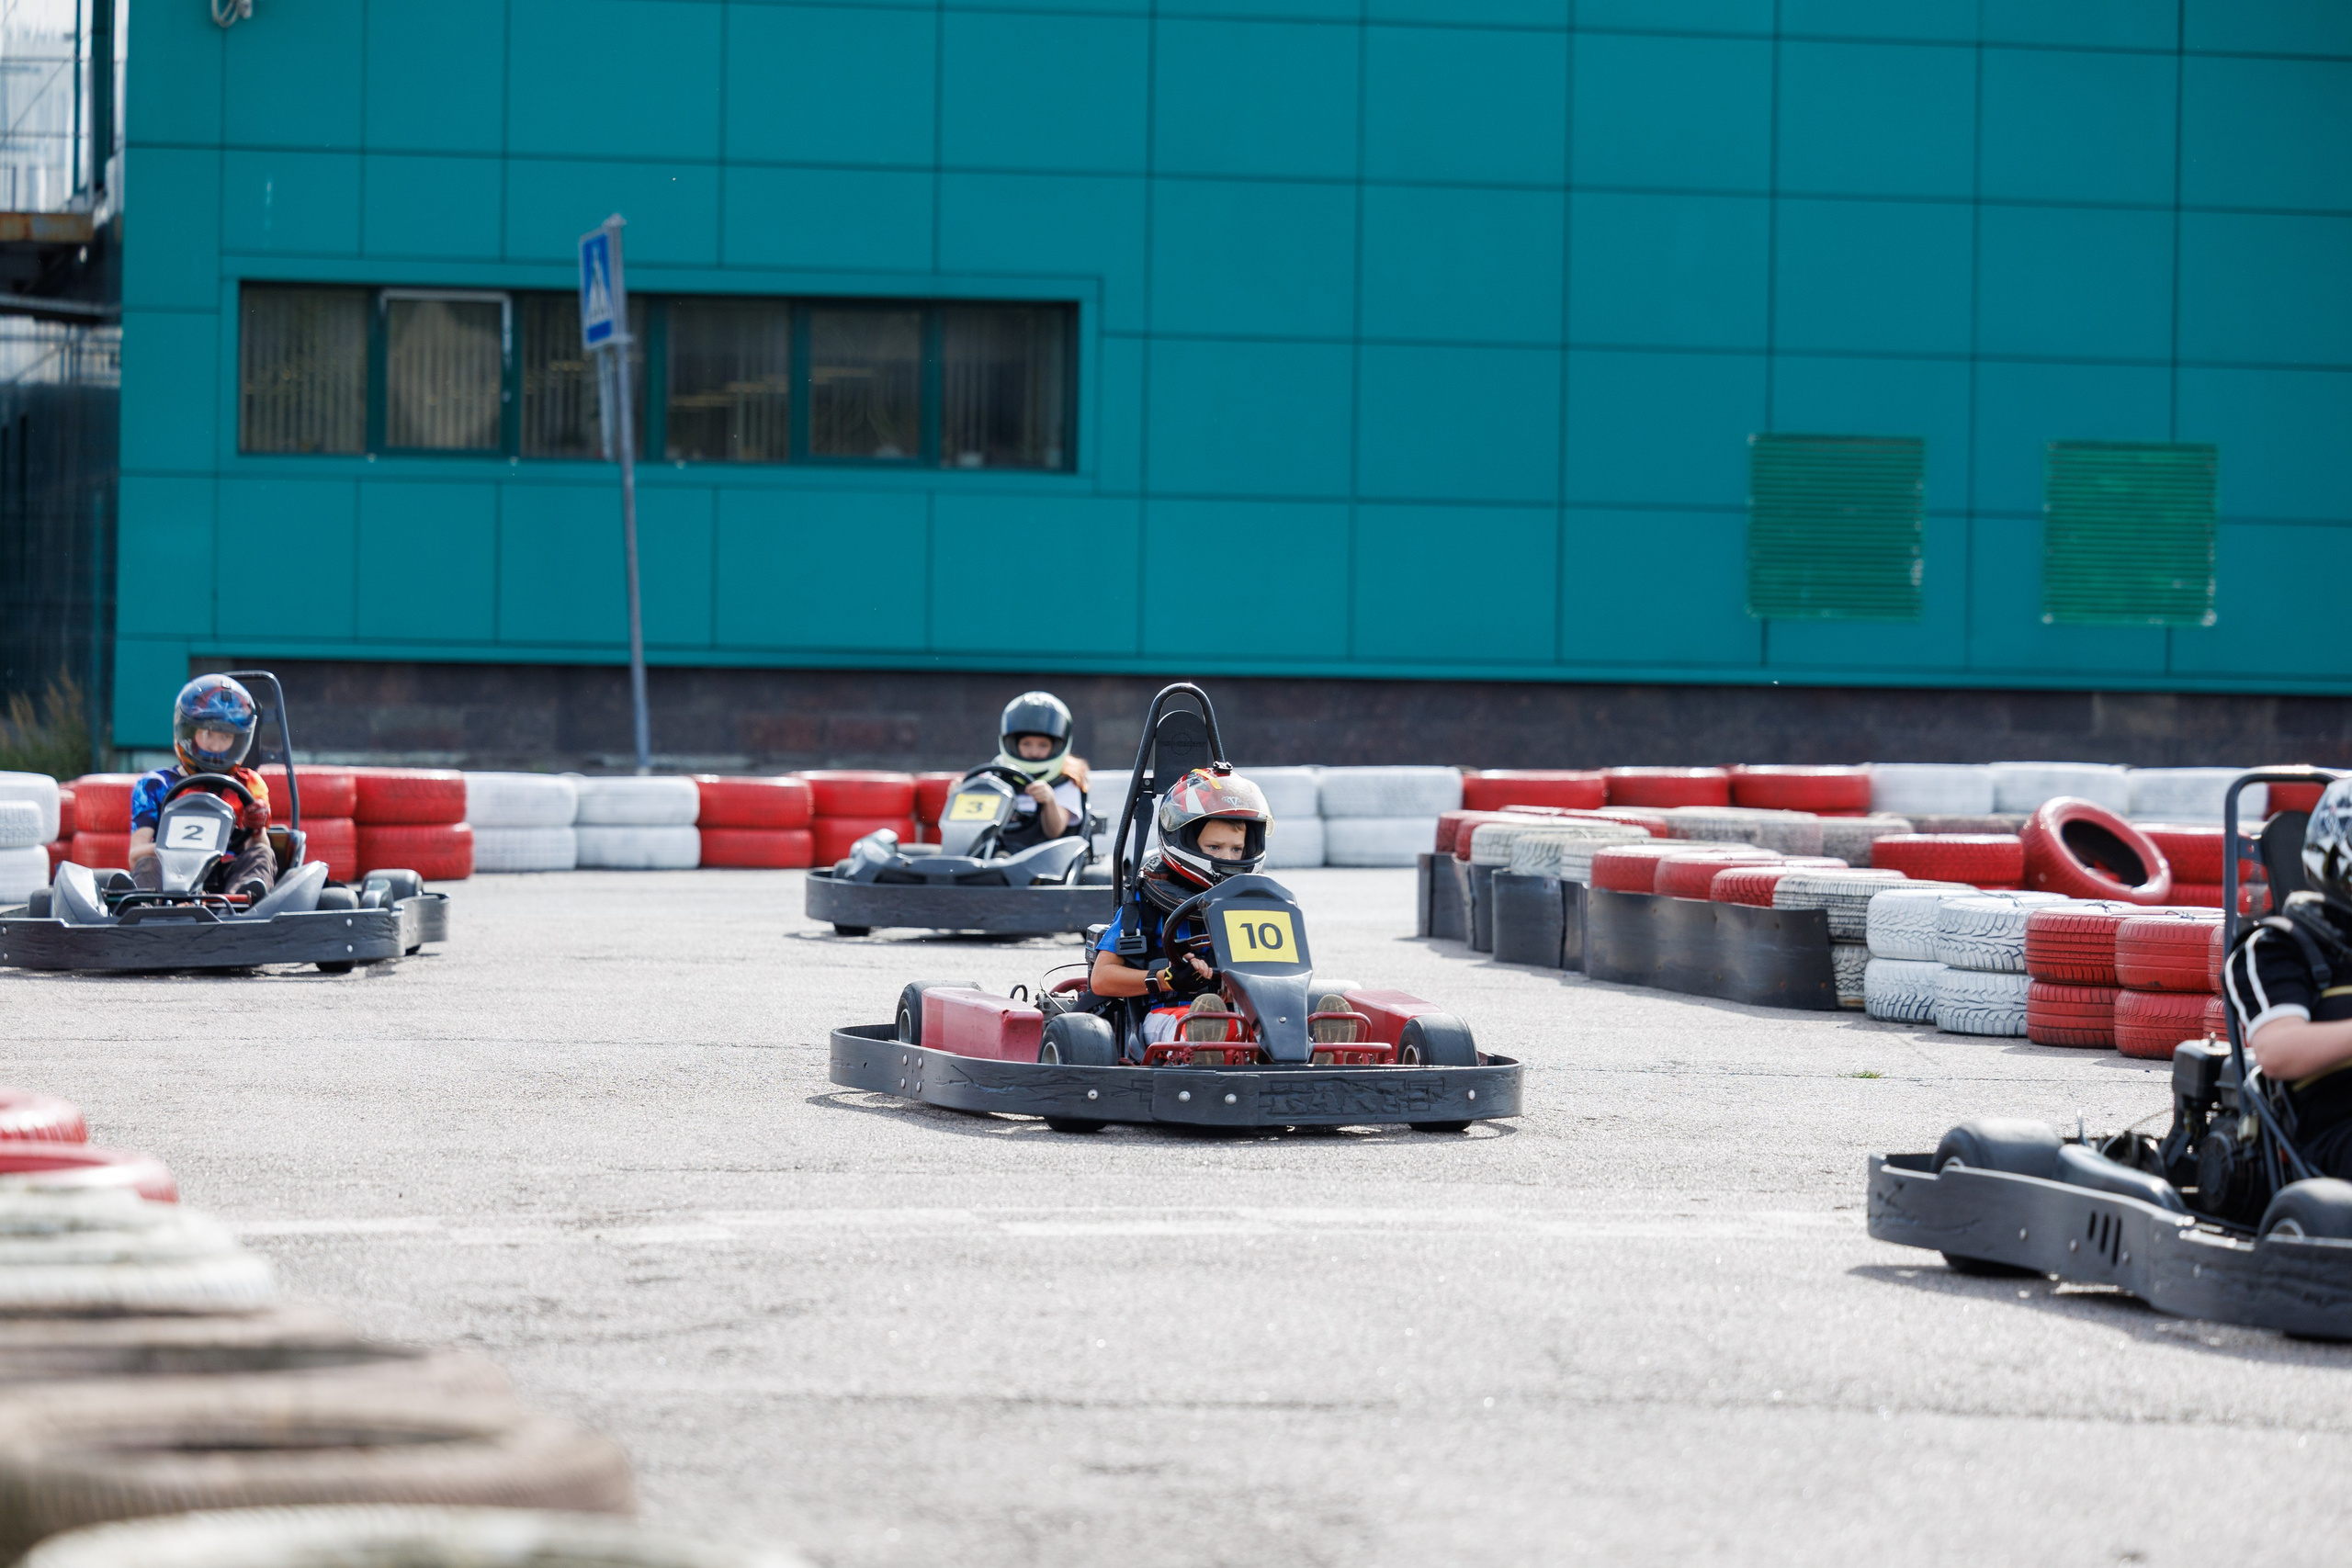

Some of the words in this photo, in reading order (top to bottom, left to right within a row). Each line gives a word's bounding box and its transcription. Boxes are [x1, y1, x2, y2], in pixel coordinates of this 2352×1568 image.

[966, 800, 984, 815] 3
[182, 825, 204, 840] 2
[1239, 922, 1283, 950] 10
